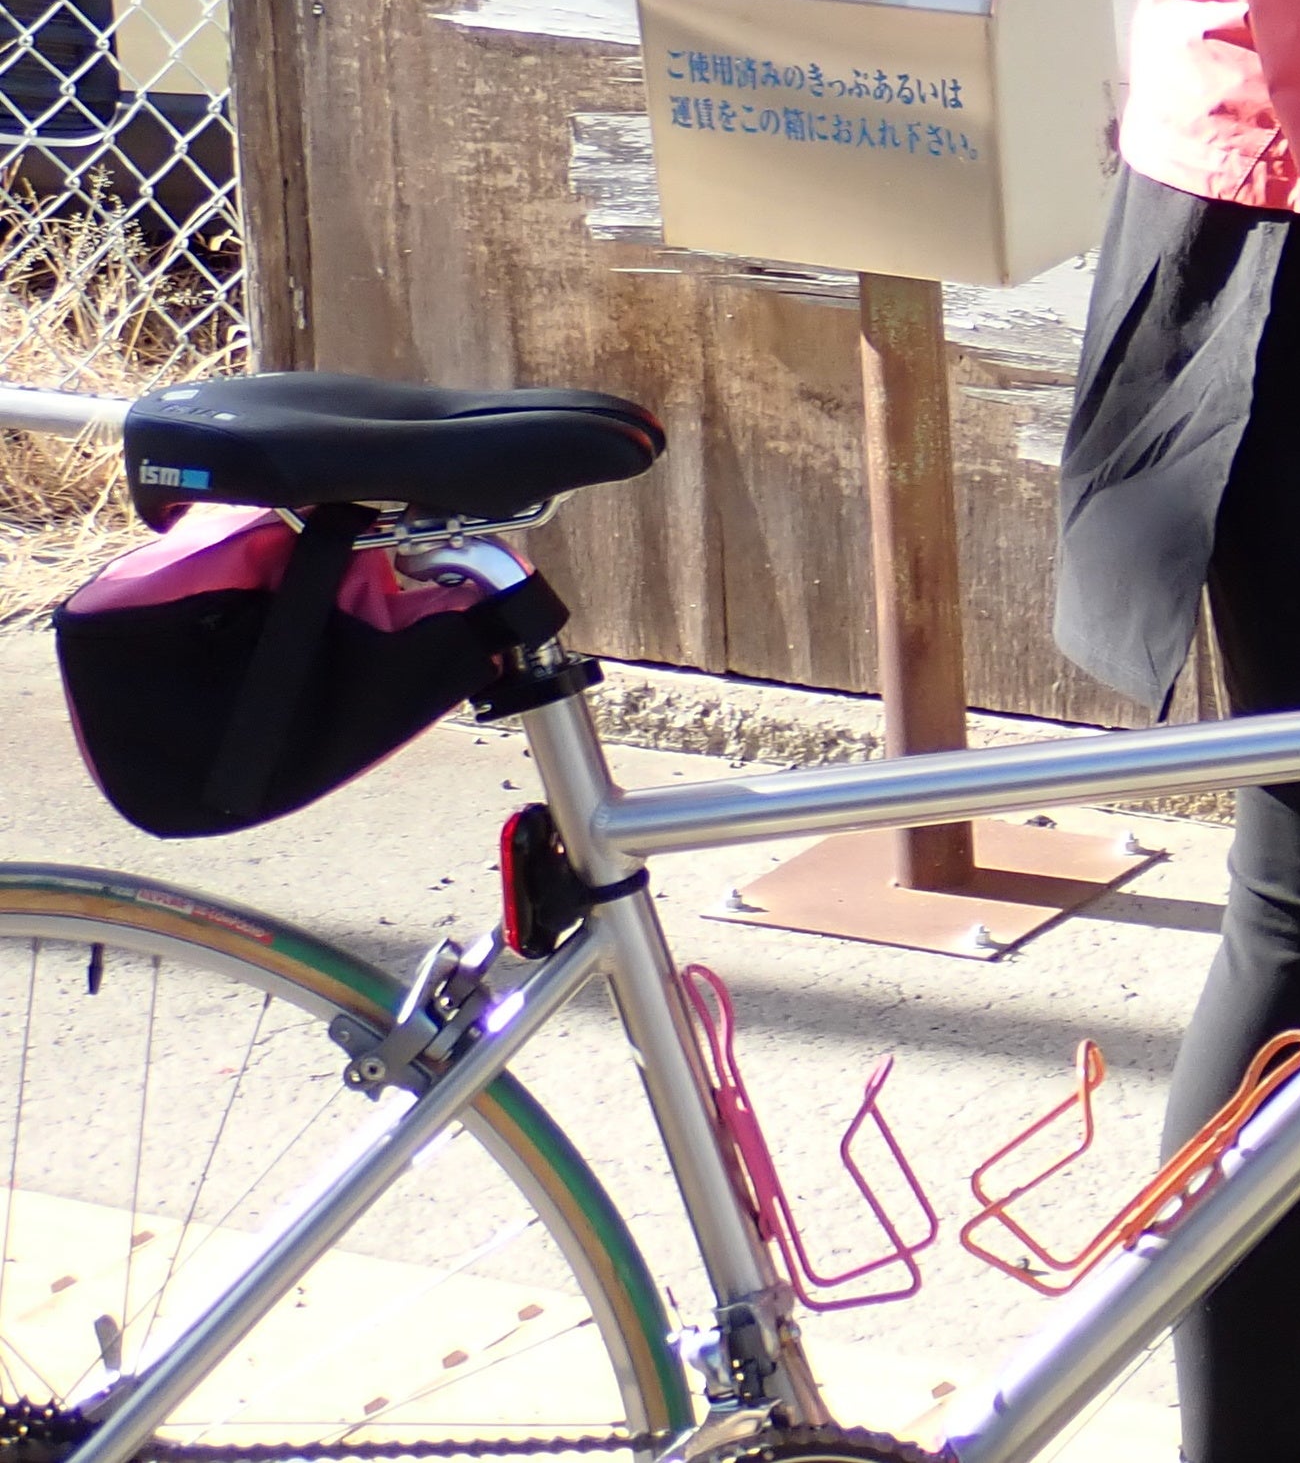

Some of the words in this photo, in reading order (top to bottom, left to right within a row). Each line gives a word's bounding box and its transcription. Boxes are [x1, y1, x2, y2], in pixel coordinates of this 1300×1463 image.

[666, 49, 964, 109] ご使用済みのきっぷあるいは
[669, 95, 978, 160] 運賃をこの箱にお入れ下さい。
[138, 458, 181, 488] ism
